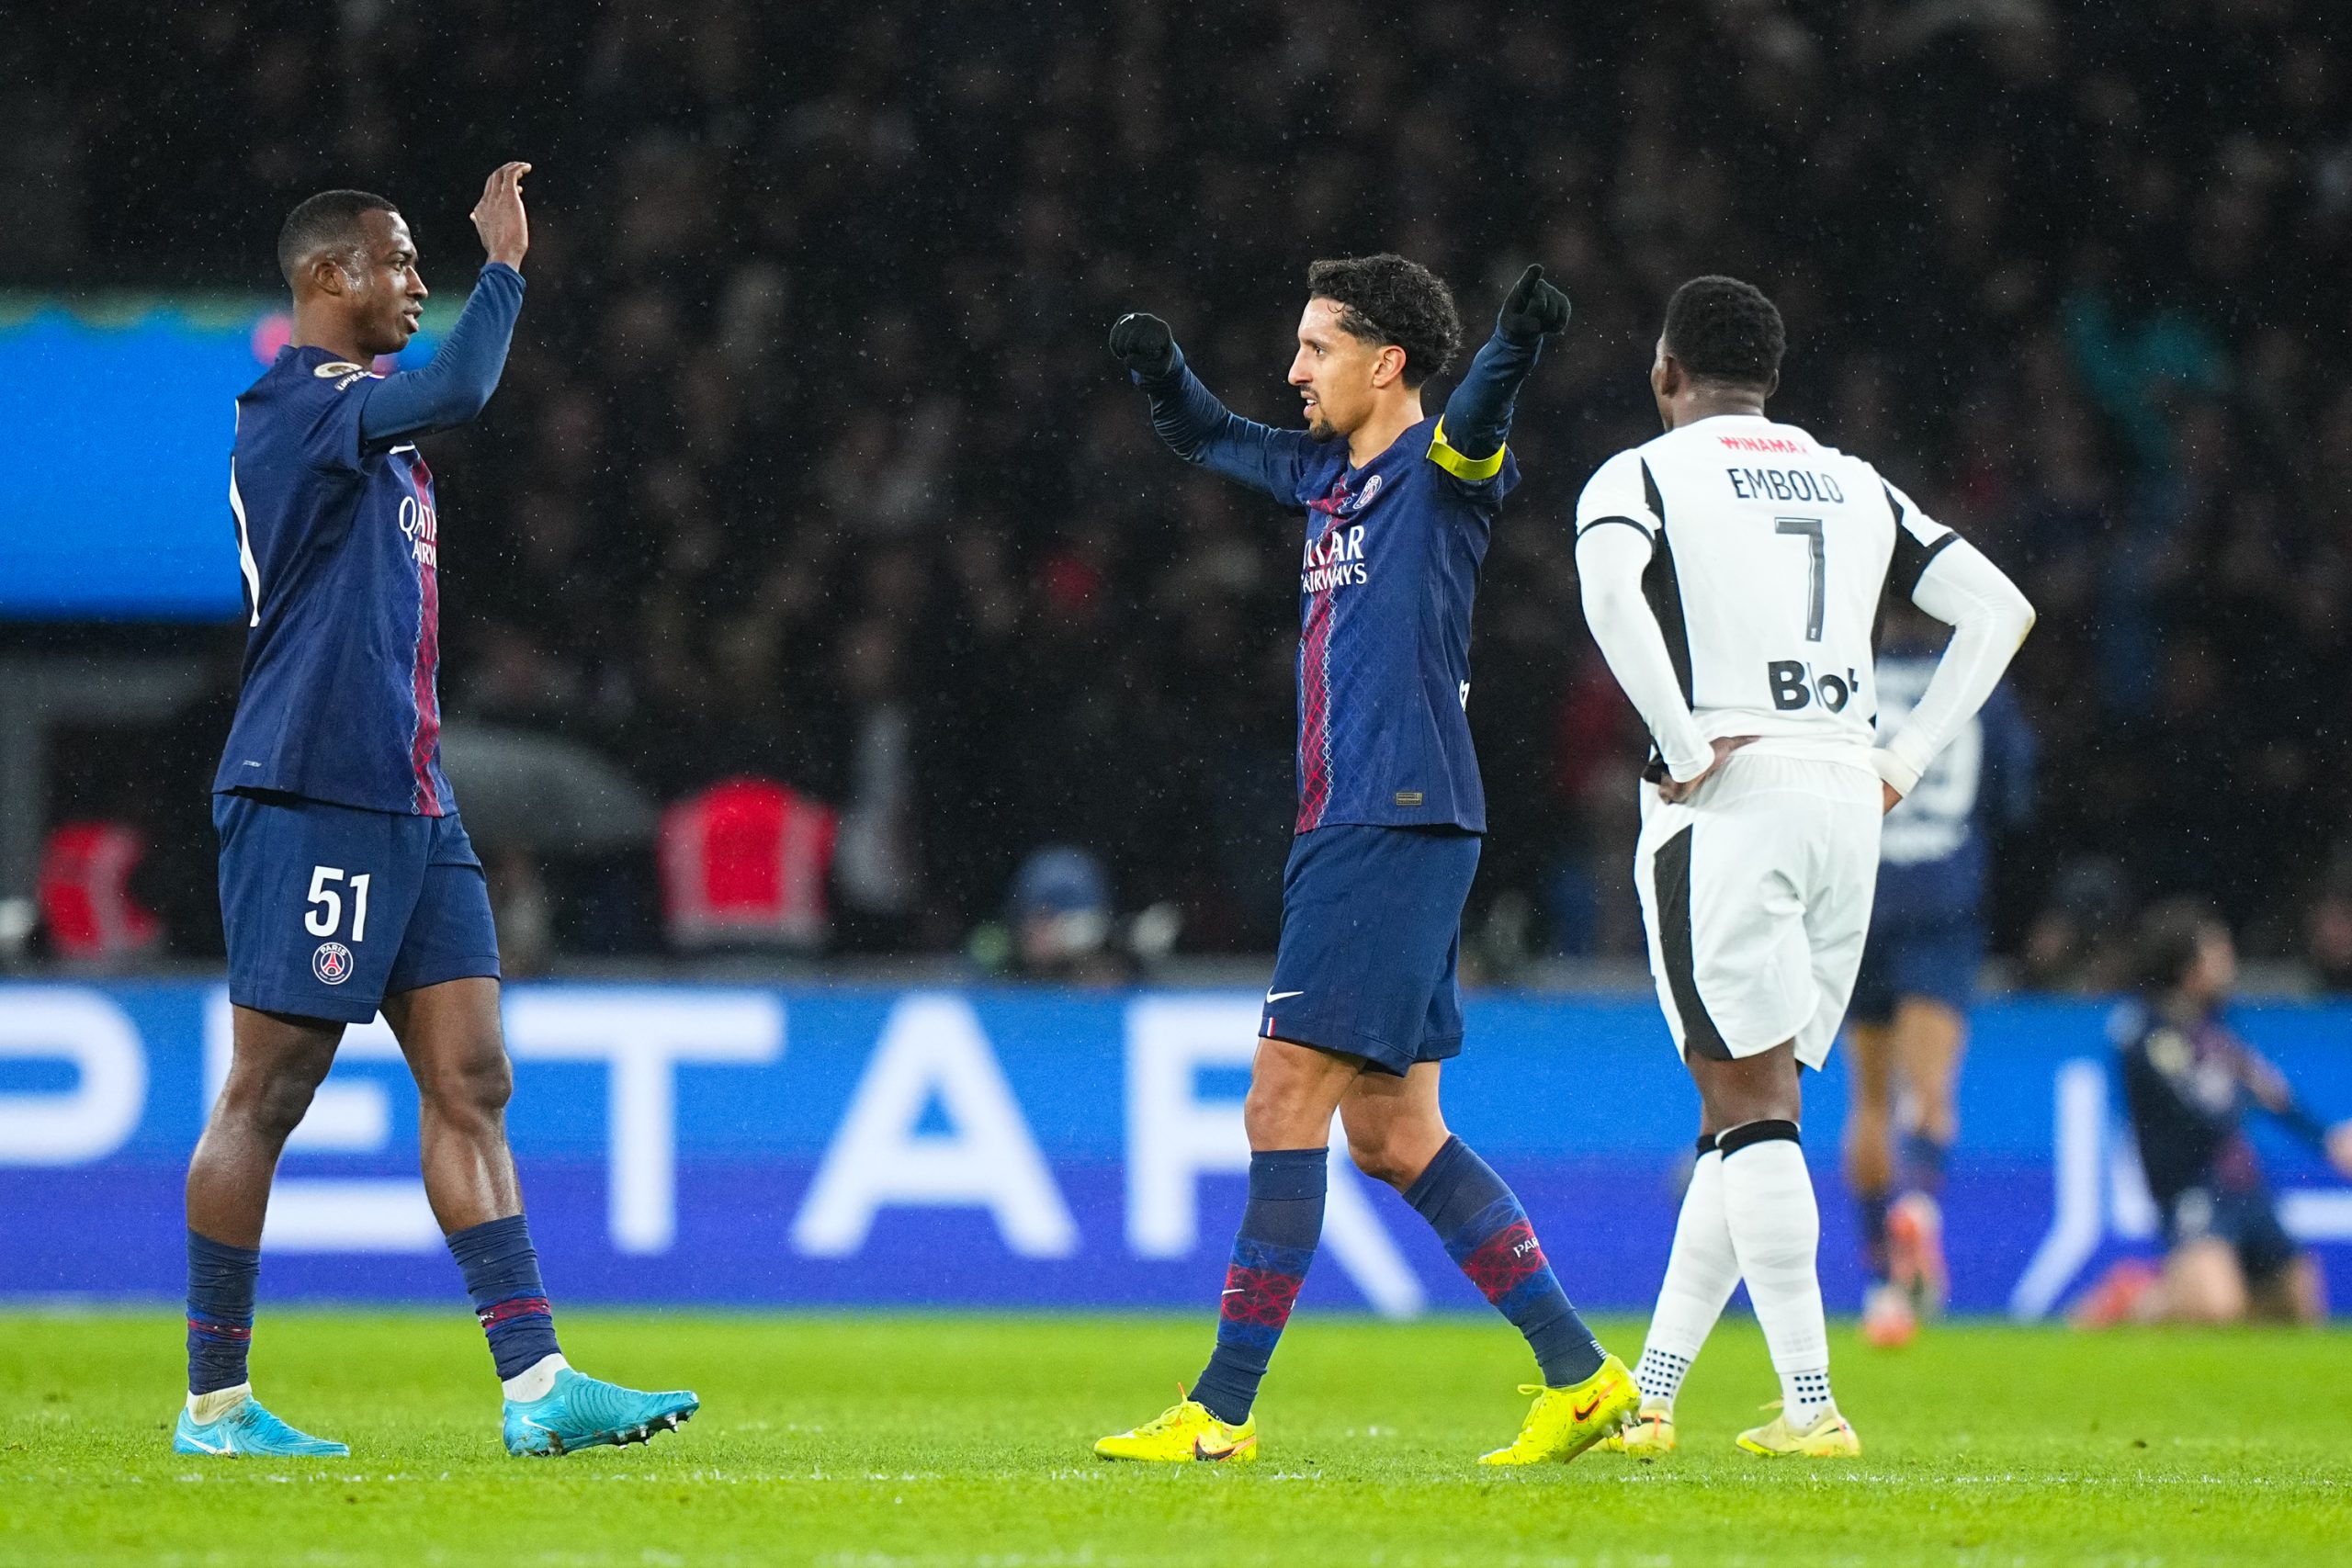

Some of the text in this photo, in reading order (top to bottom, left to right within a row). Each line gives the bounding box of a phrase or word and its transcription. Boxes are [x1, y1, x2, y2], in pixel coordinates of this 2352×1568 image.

[1725, 468, 1845, 504] EMBOLO
[1302, 562, 1368, 594] AIRWAYS
[1774, 516, 1826, 642] 7
[304, 865, 370, 942] 51
[320, 944, 347, 956] PARIS
